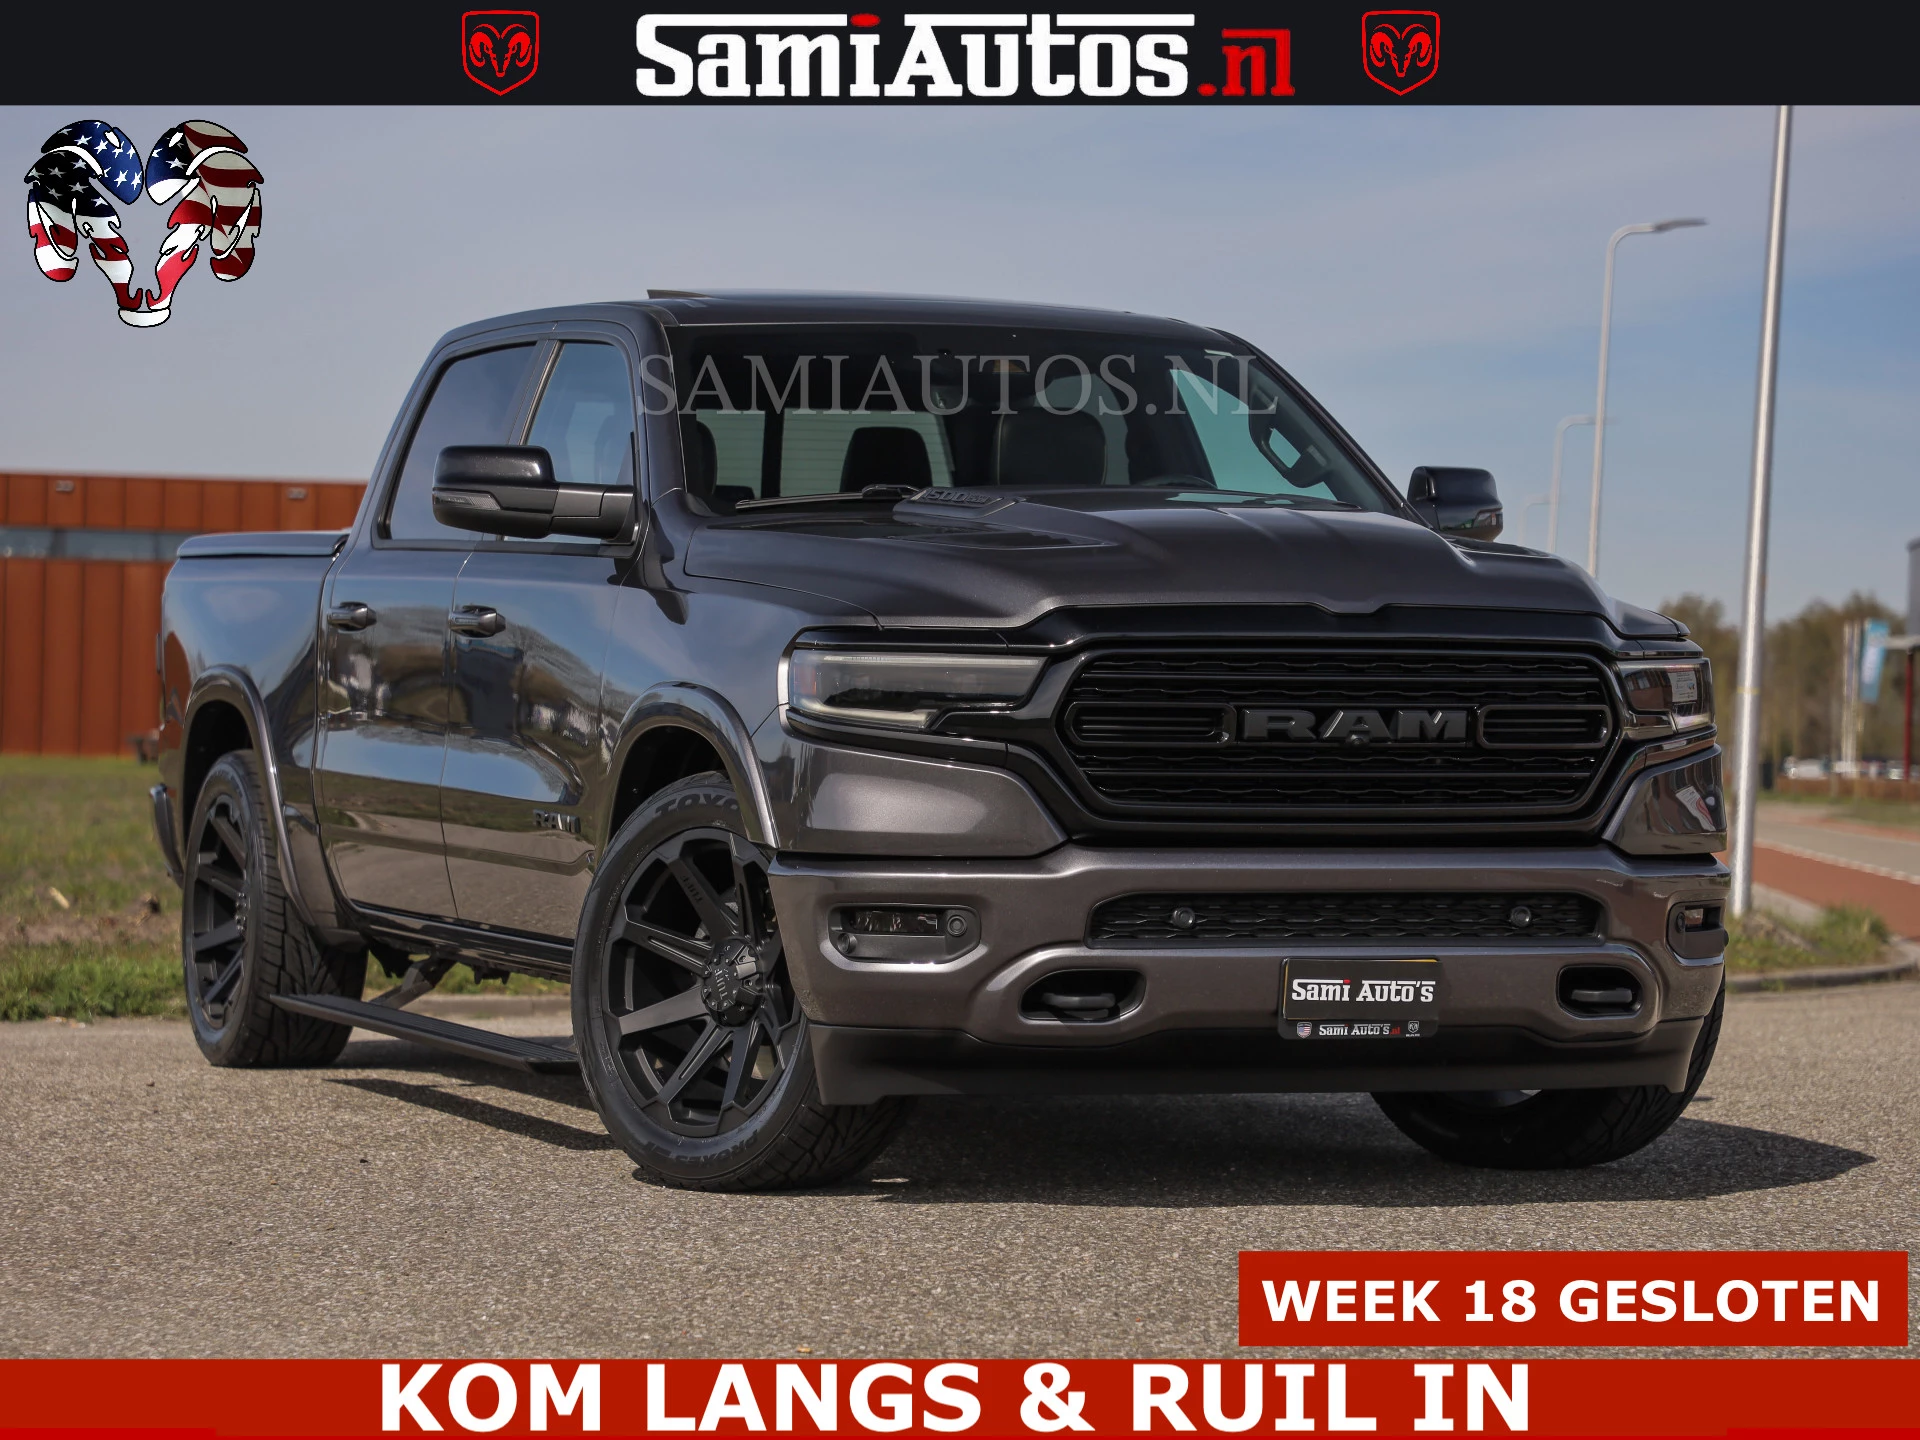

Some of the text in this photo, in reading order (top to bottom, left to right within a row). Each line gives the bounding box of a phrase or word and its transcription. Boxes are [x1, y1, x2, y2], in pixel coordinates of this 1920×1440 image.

[1243, 709, 1468, 741] RAM
[654, 793, 740, 817] TOYO
[1292, 979, 1436, 1003] Sami Auto's
[1319, 1024, 1349, 1036] Sami
